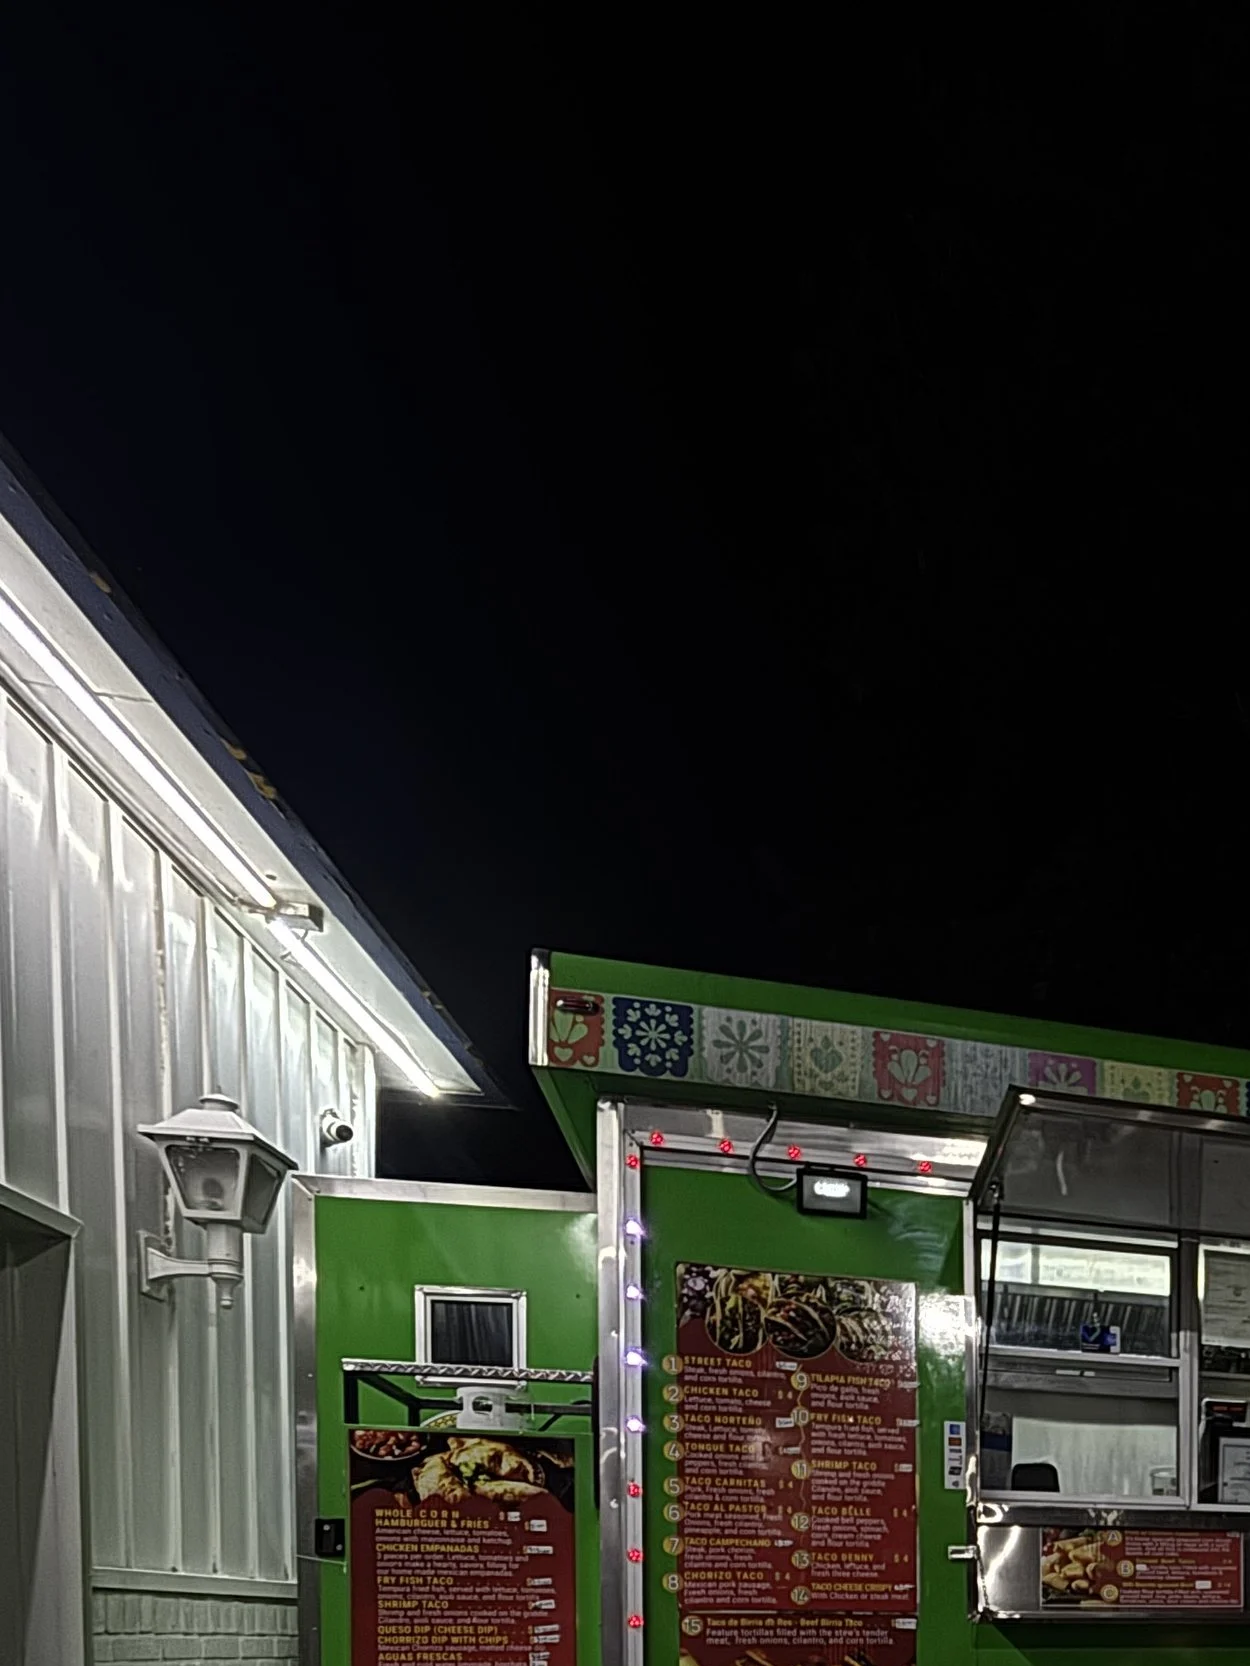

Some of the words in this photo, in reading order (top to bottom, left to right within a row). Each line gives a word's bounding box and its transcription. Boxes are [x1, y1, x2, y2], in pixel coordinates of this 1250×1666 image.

[669, 1358, 676, 1371] 1
[684, 1356, 722, 1366] STREET
[726, 1358, 752, 1368] TACO
[797, 1372, 807, 1387] 9
[810, 1373, 845, 1384] TILAPIA
[847, 1376, 867, 1386] FISH
[868, 1376, 891, 1388] TACO
[668, 1386, 679, 1401] 2
[684, 1386, 729, 1396] CHICKEN
[733, 1388, 759, 1398] TACO
[669, 1415, 679, 1430] 3
[684, 1414, 711, 1423] TACO
[793, 1408, 809, 1424] 10
[810, 1412, 829, 1422] FRY
[857, 1415, 882, 1425] TACO
[669, 1444, 680, 1458] 4
[684, 1442, 724, 1452] TONGUE
[729, 1444, 755, 1453] TACO
[796, 1462, 806, 1477] 11
[810, 1460, 850, 1470] SHRIMP
[852, 1461, 877, 1471] TACO
[669, 1478, 680, 1493] 5
[684, 1476, 712, 1486] TACO
[715, 1478, 766, 1488] CARNITAS
[788, 1480, 794, 1488] 4
[375, 1508, 412, 1518] WHOLE
[669, 1504, 680, 1519] 6
[684, 1502, 710, 1512] TACO
[713, 1503, 724, 1512] AL
[728, 1503, 767, 1512] PASTOR
[794, 1516, 810, 1529] 12
[811, 1506, 838, 1515] TACO
[375, 1518, 448, 1528] HAMBURGUER
[450, 1519, 458, 1528] &
[460, 1519, 490, 1529] FRIES
[1108, 1531, 1121, 1542] A
[375, 1544, 418, 1553] CHICKEN
[420, 1544, 480, 1554] EMPANADAS
[669, 1538, 680, 1552] 7
[684, 1537, 708, 1546] TACO
[710, 1538, 772, 1548] CAMPECHANO
[794, 1553, 810, 1567] 13
[811, 1552, 838, 1561] TACO
[377, 1576, 396, 1585] FRY
[400, 1576, 423, 1585] FISH
[427, 1576, 454, 1586] TACO
[668, 1573, 680, 1588] 8
[684, 1571, 732, 1580] CHORIZO
[736, 1572, 764, 1580] TACO
[793, 1589, 808, 1603] 14
[810, 1582, 832, 1592] TACO
[830, 1592, 859, 1600] Chicken
[378, 1600, 418, 1608] SHRIMP
[422, 1600, 449, 1608] TACO
[378, 1626, 411, 1634] QUESO
[414, 1626, 431, 1634] DIP
[434, 1626, 475, 1634] (CHEESE
[477, 1626, 498, 1635] DIP)
[685, 1620, 701, 1633] 15
[707, 1618, 726, 1626] Taco
[728, 1618, 738, 1626] de
[800, 1618, 818, 1626] Beef
[834, 1629, 860, 1637] stew's
[862, 1629, 888, 1637] tender
[378, 1636, 428, 1644] CHORRIZO
[431, 1636, 448, 1644] DIP
[450, 1636, 476, 1644] WITH
[478, 1636, 508, 1644] CHIPS
[760, 1638, 789, 1646] onions,
[792, 1637, 827, 1646] cilantro,
[378, 1652, 413, 1661] AGUAS
[416, 1652, 463, 1661] FRESCAS
